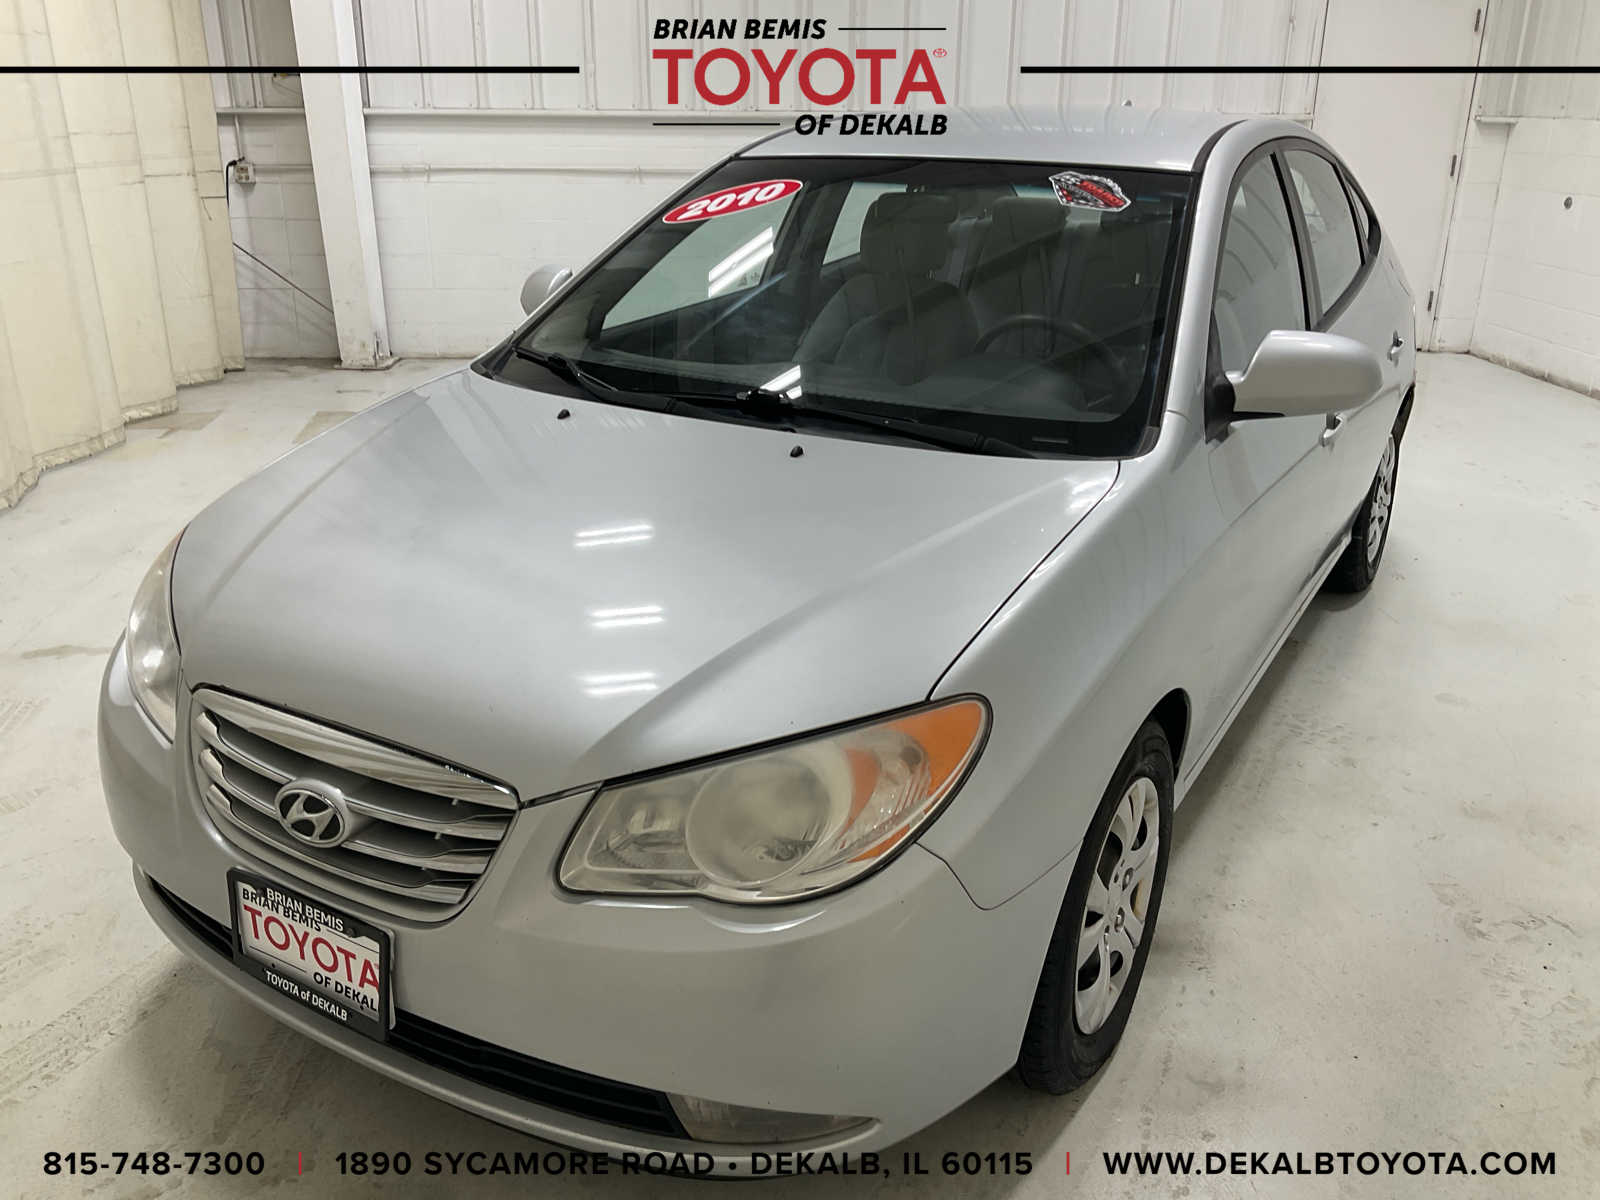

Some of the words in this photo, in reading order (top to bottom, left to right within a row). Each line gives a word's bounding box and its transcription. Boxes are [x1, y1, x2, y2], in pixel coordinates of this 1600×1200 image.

[676, 182, 786, 221] 2010
[266, 887, 303, 915] BRIAN
[305, 904, 344, 932] BEMIS
[243, 904, 380, 992] TOYOTA
[265, 970, 300, 997] TOYOTA
[300, 990, 311, 1001] of
[311, 993, 348, 1021] DEKALB
[313, 971, 332, 988] OF
[334, 980, 377, 1011] DEKAL
